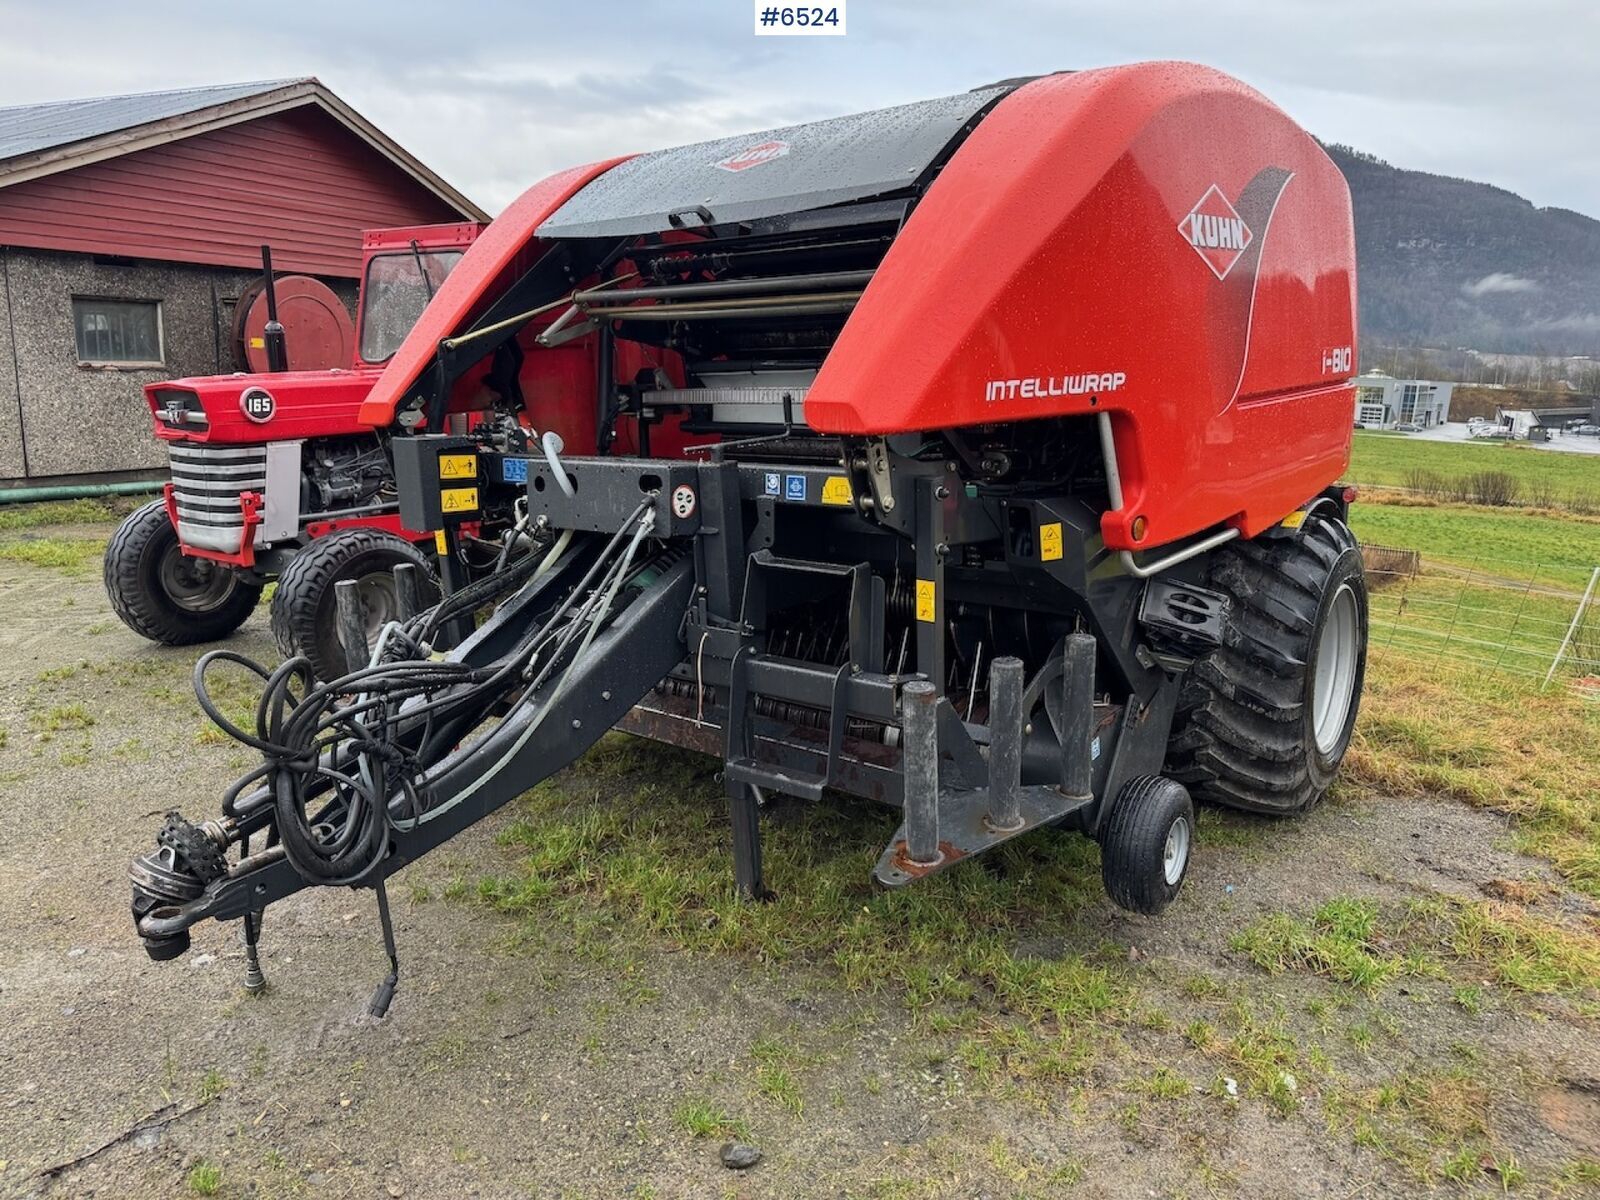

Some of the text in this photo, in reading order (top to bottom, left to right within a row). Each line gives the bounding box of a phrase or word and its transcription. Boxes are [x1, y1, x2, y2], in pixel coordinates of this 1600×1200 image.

[1190, 213, 1244, 250] KUHN
[986, 372, 1126, 401] INTELLIWRAP
[249, 398, 270, 412] 165
